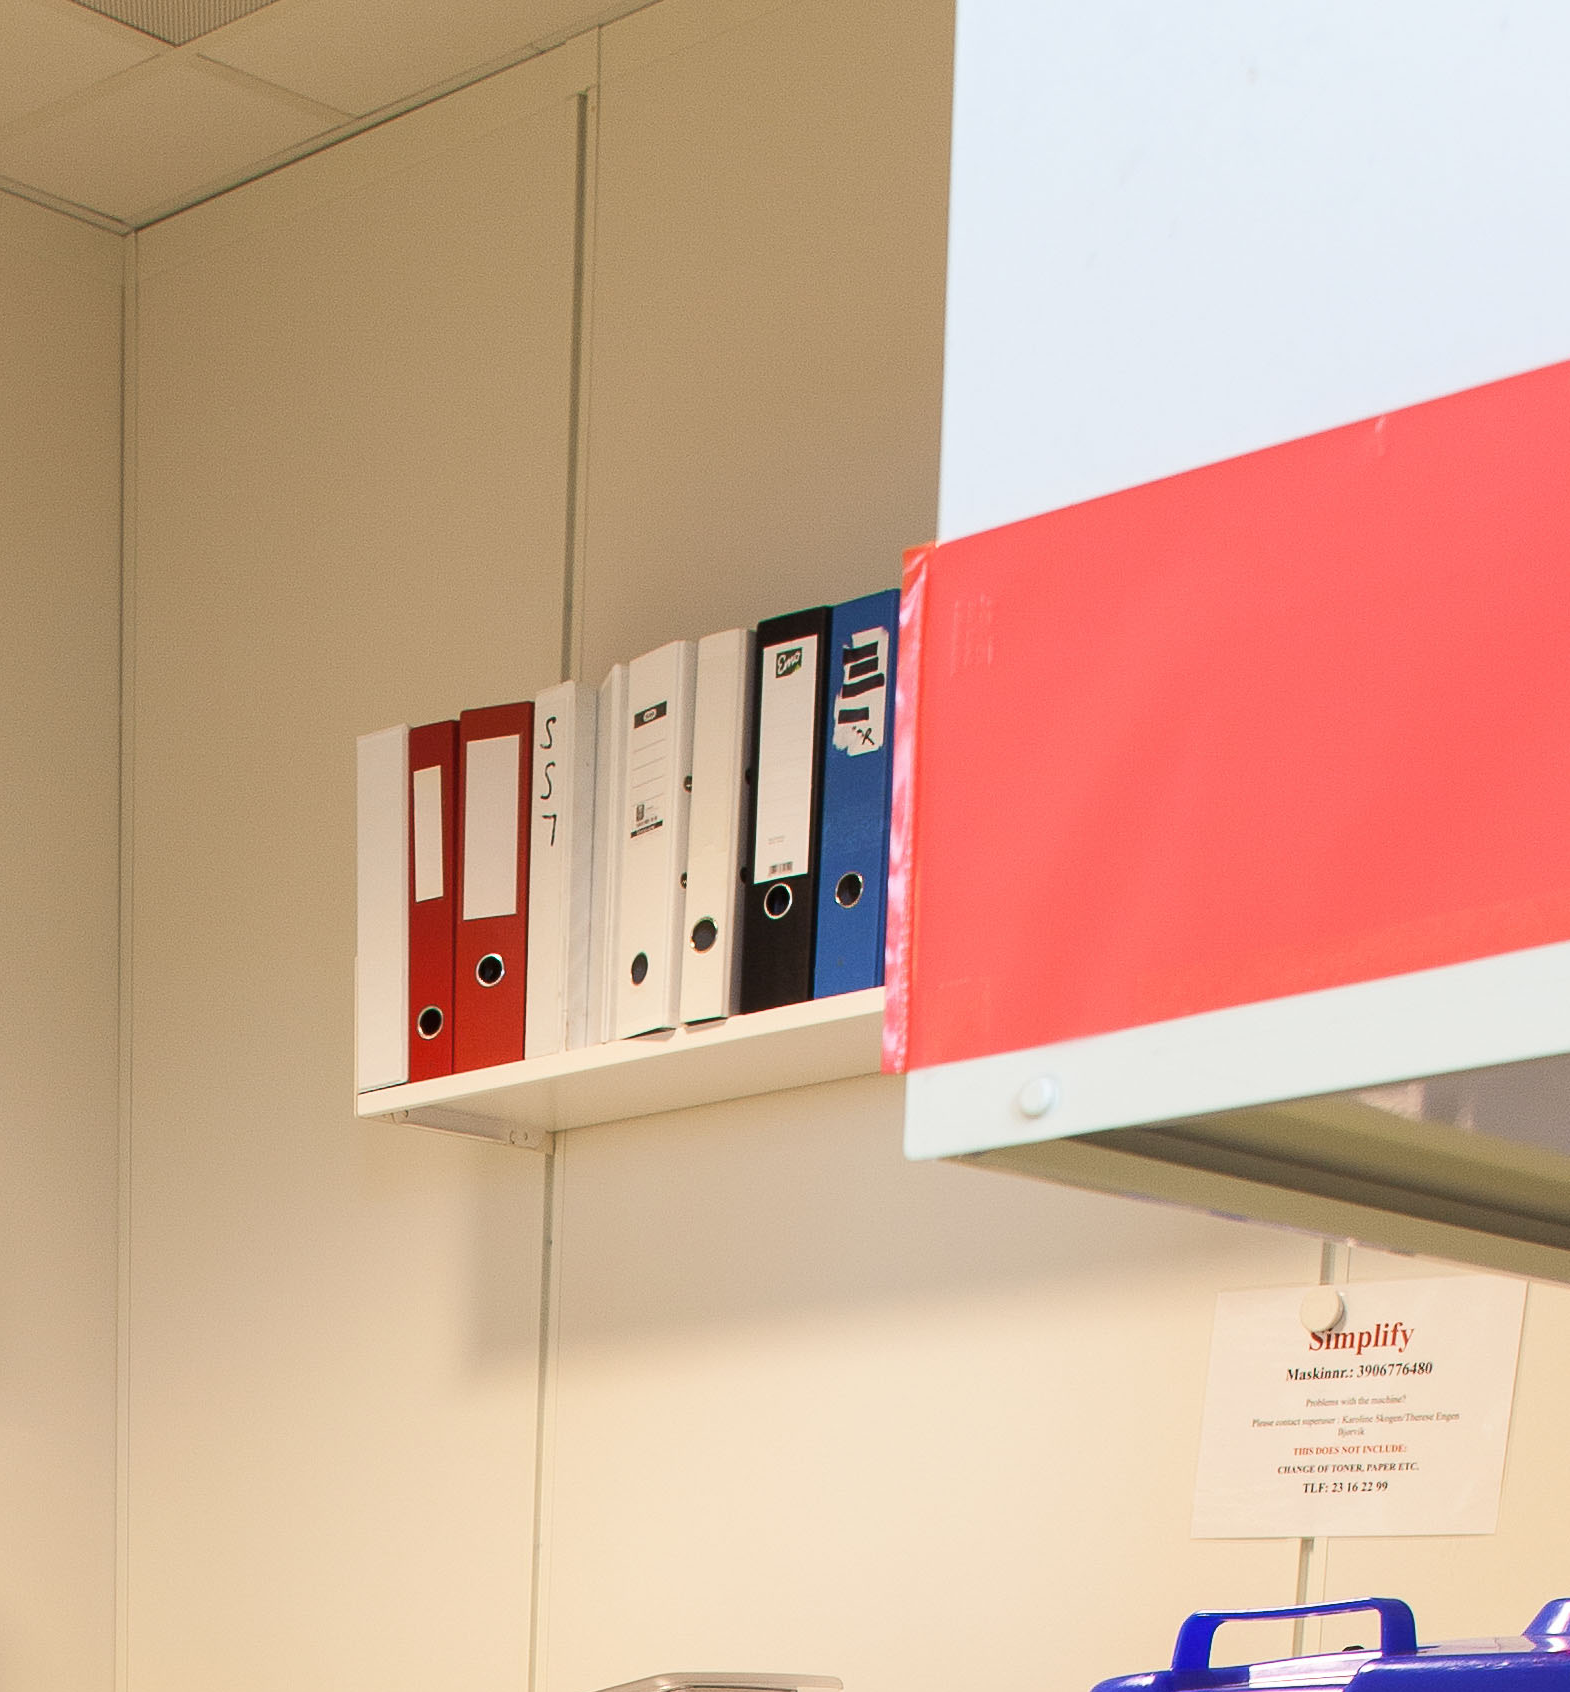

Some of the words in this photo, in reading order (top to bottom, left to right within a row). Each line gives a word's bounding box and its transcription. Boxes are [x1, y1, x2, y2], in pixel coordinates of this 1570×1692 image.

[1309, 1321, 1415, 1356] Simplify
[1286, 1367, 1354, 1381] Maskinnr.:
[1357, 1361, 1433, 1379] 3906776480
[1341, 1397, 1357, 1406] with
[1294, 1447, 1314, 1456] THIS
[1316, 1446, 1340, 1455] DOES
[1342, 1445, 1360, 1455] NOT
[1277, 1465, 1315, 1474] CHANGE
[1317, 1464, 1330, 1473] OF
[1366, 1462, 1397, 1472] PAPER
[1303, 1482, 1328, 1493] TLF:
[1331, 1482, 1343, 1493] 23
[1347, 1481, 1358, 1492] 16
[1361, 1481, 1373, 1492] 22
[1376, 1480, 1388, 1491] 99
